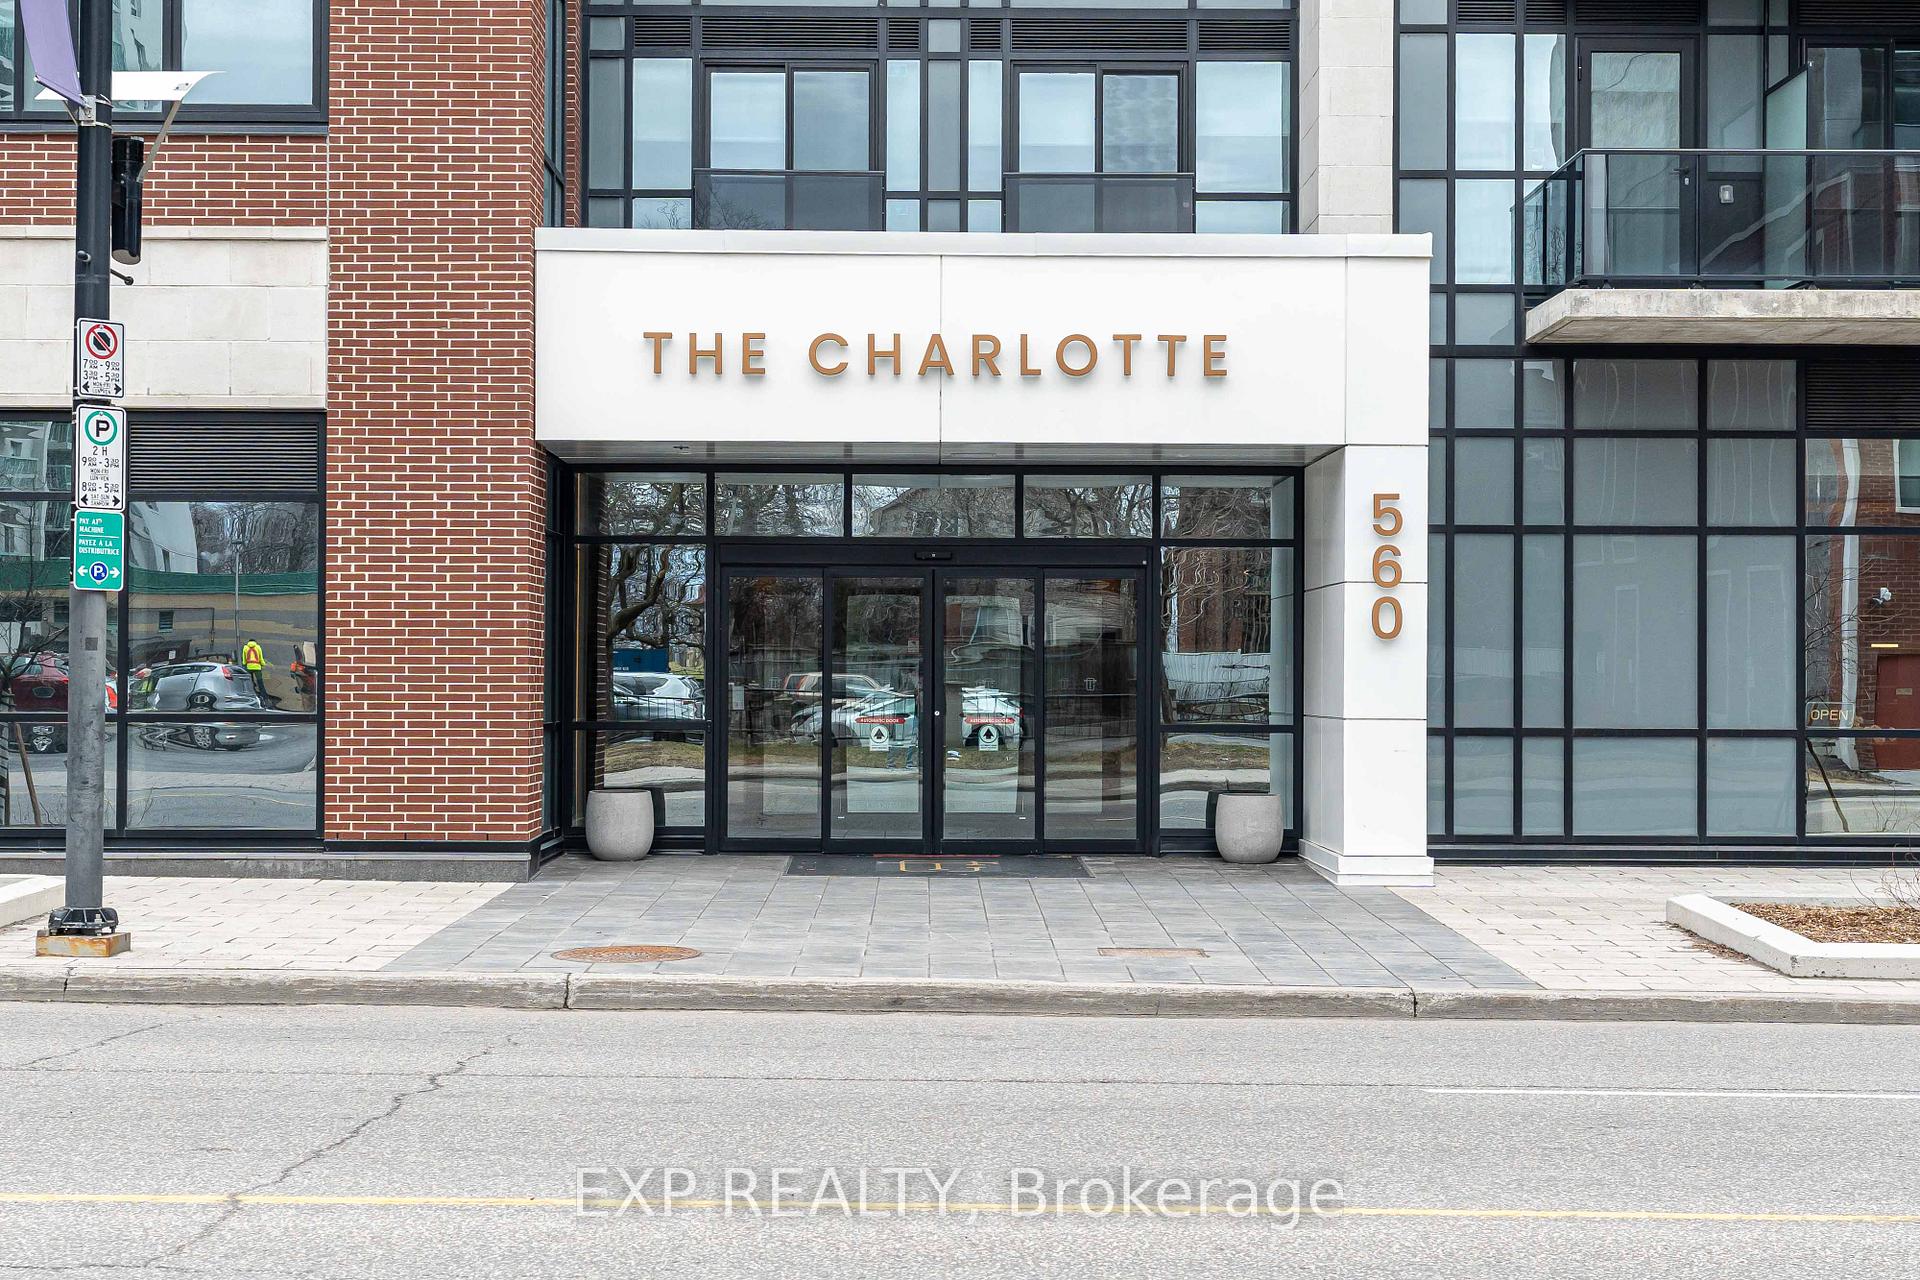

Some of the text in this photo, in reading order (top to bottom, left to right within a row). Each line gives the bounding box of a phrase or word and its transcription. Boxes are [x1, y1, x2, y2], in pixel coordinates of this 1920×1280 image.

[644, 332, 1228, 376] THE CHARLOTTE
[96, 420, 110, 437] P
[93, 446, 107, 456] 2 H
[79, 547, 120, 555] DISTRIBUTRICE
[1372, 493, 1403, 640] 560
[1810, 709, 1848, 720] OPEN
